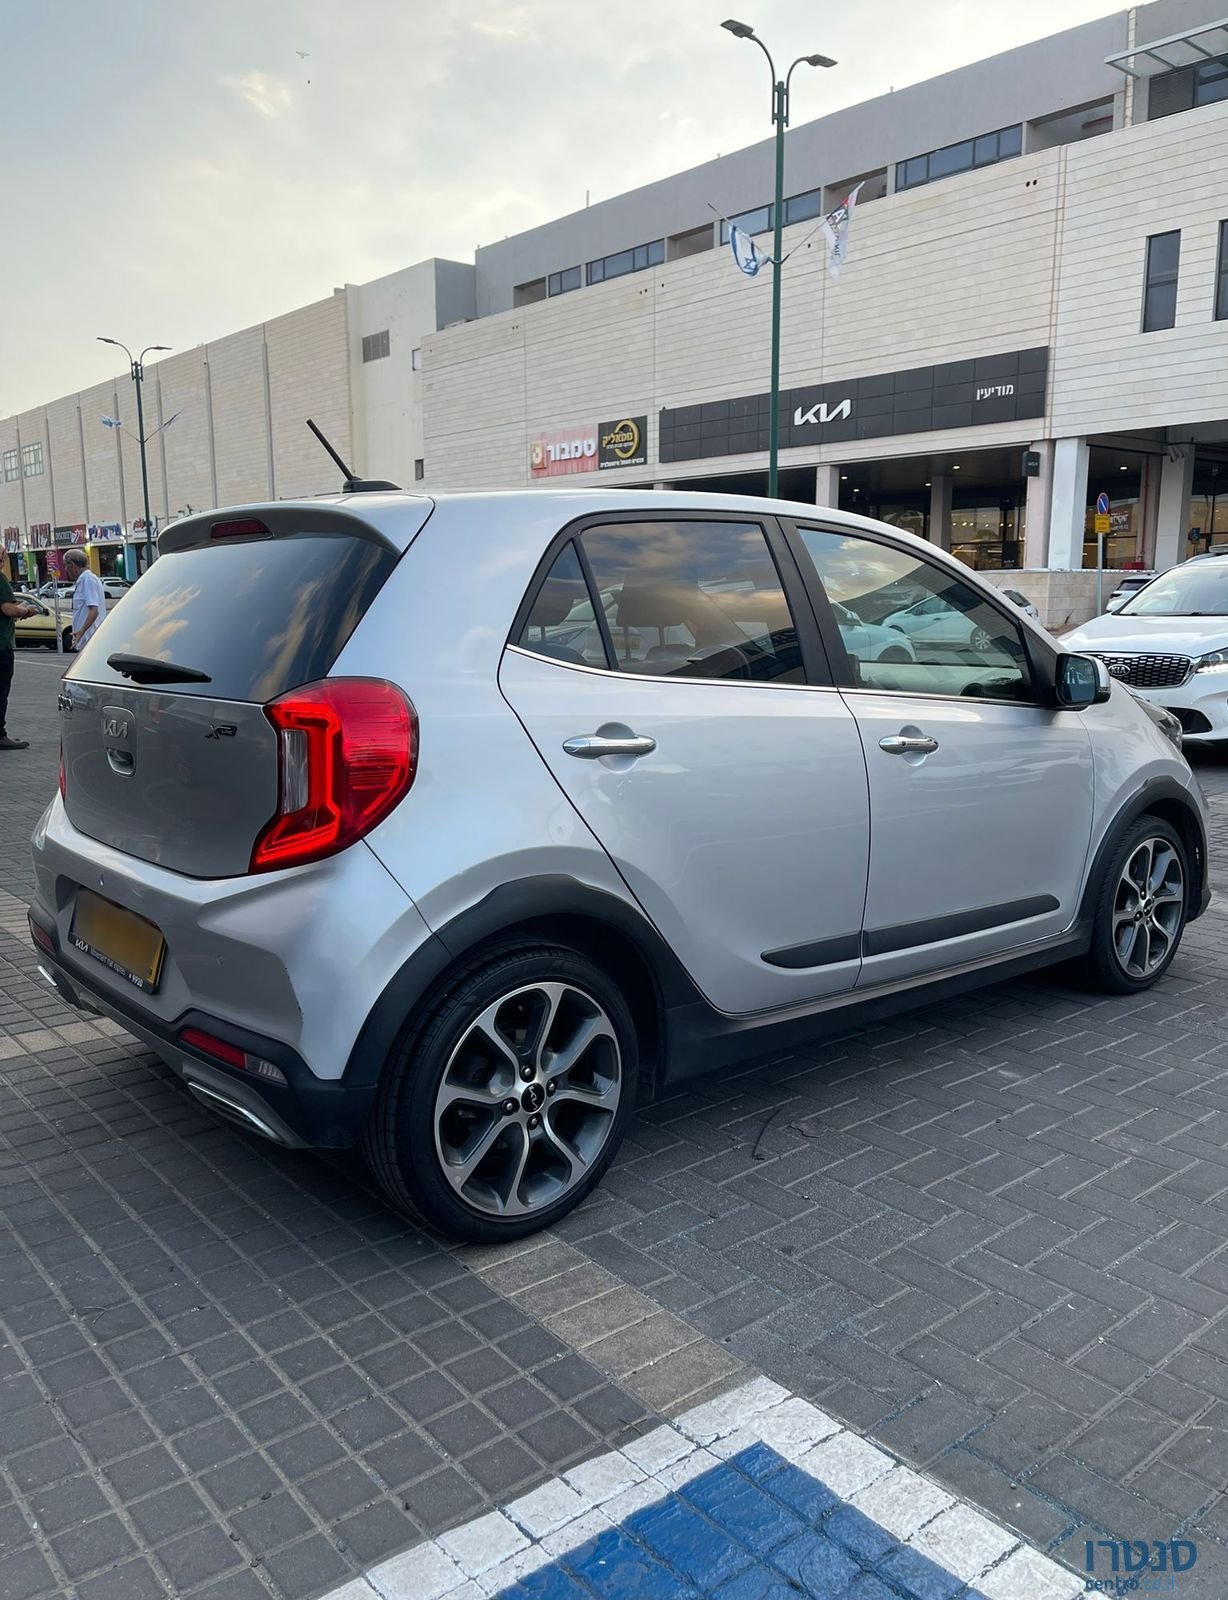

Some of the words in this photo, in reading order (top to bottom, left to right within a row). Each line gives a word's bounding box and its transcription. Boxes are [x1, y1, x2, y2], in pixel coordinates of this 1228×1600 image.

[976, 384, 1014, 401] מודיעין
[793, 399, 851, 426] KIA
[546, 438, 597, 462] טמבור
[1111, 666, 1126, 674] KIA
